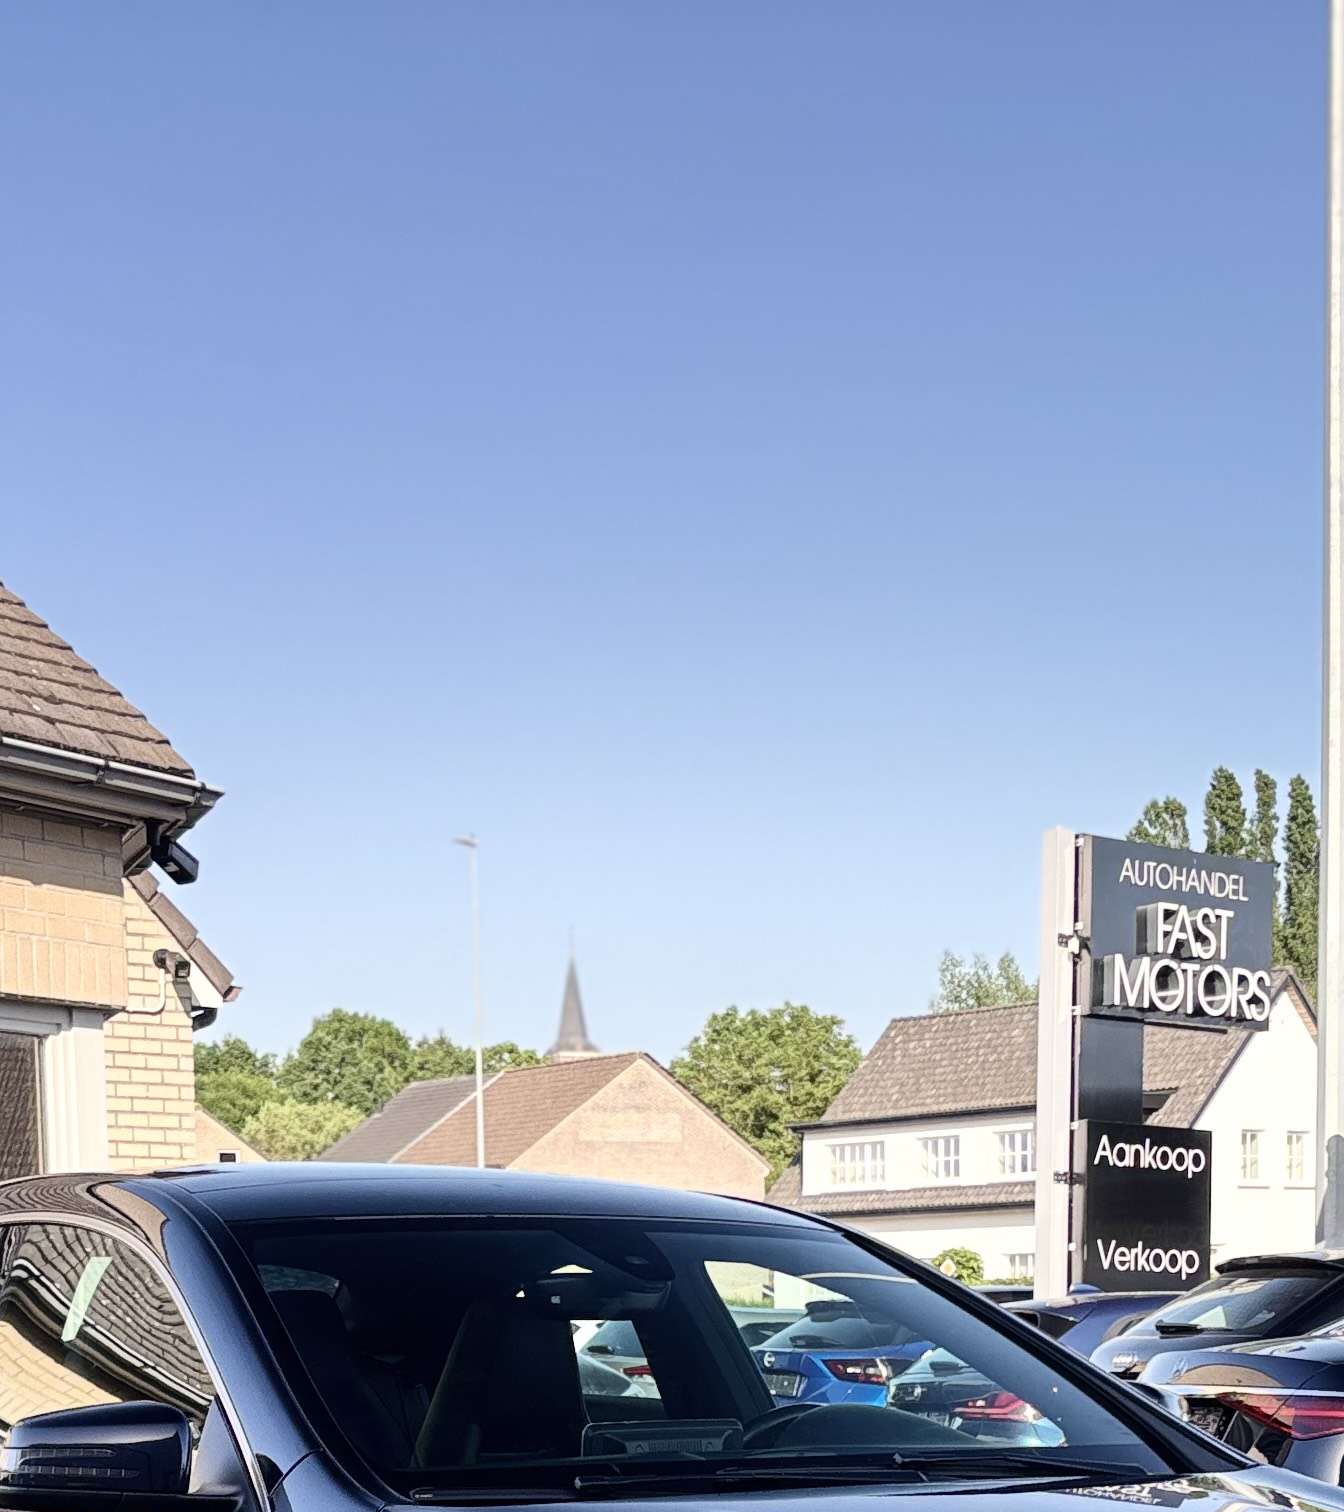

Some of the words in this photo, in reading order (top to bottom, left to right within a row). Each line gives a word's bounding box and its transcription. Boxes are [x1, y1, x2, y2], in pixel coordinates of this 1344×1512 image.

[1119, 857, 1249, 902] AUTOHANDEL
[1156, 901, 1235, 962] FAST
[1112, 952, 1272, 1023] MOTORS
[1093, 1133, 1206, 1180] Aankoop
[1096, 1238, 1200, 1281] Verkoop
